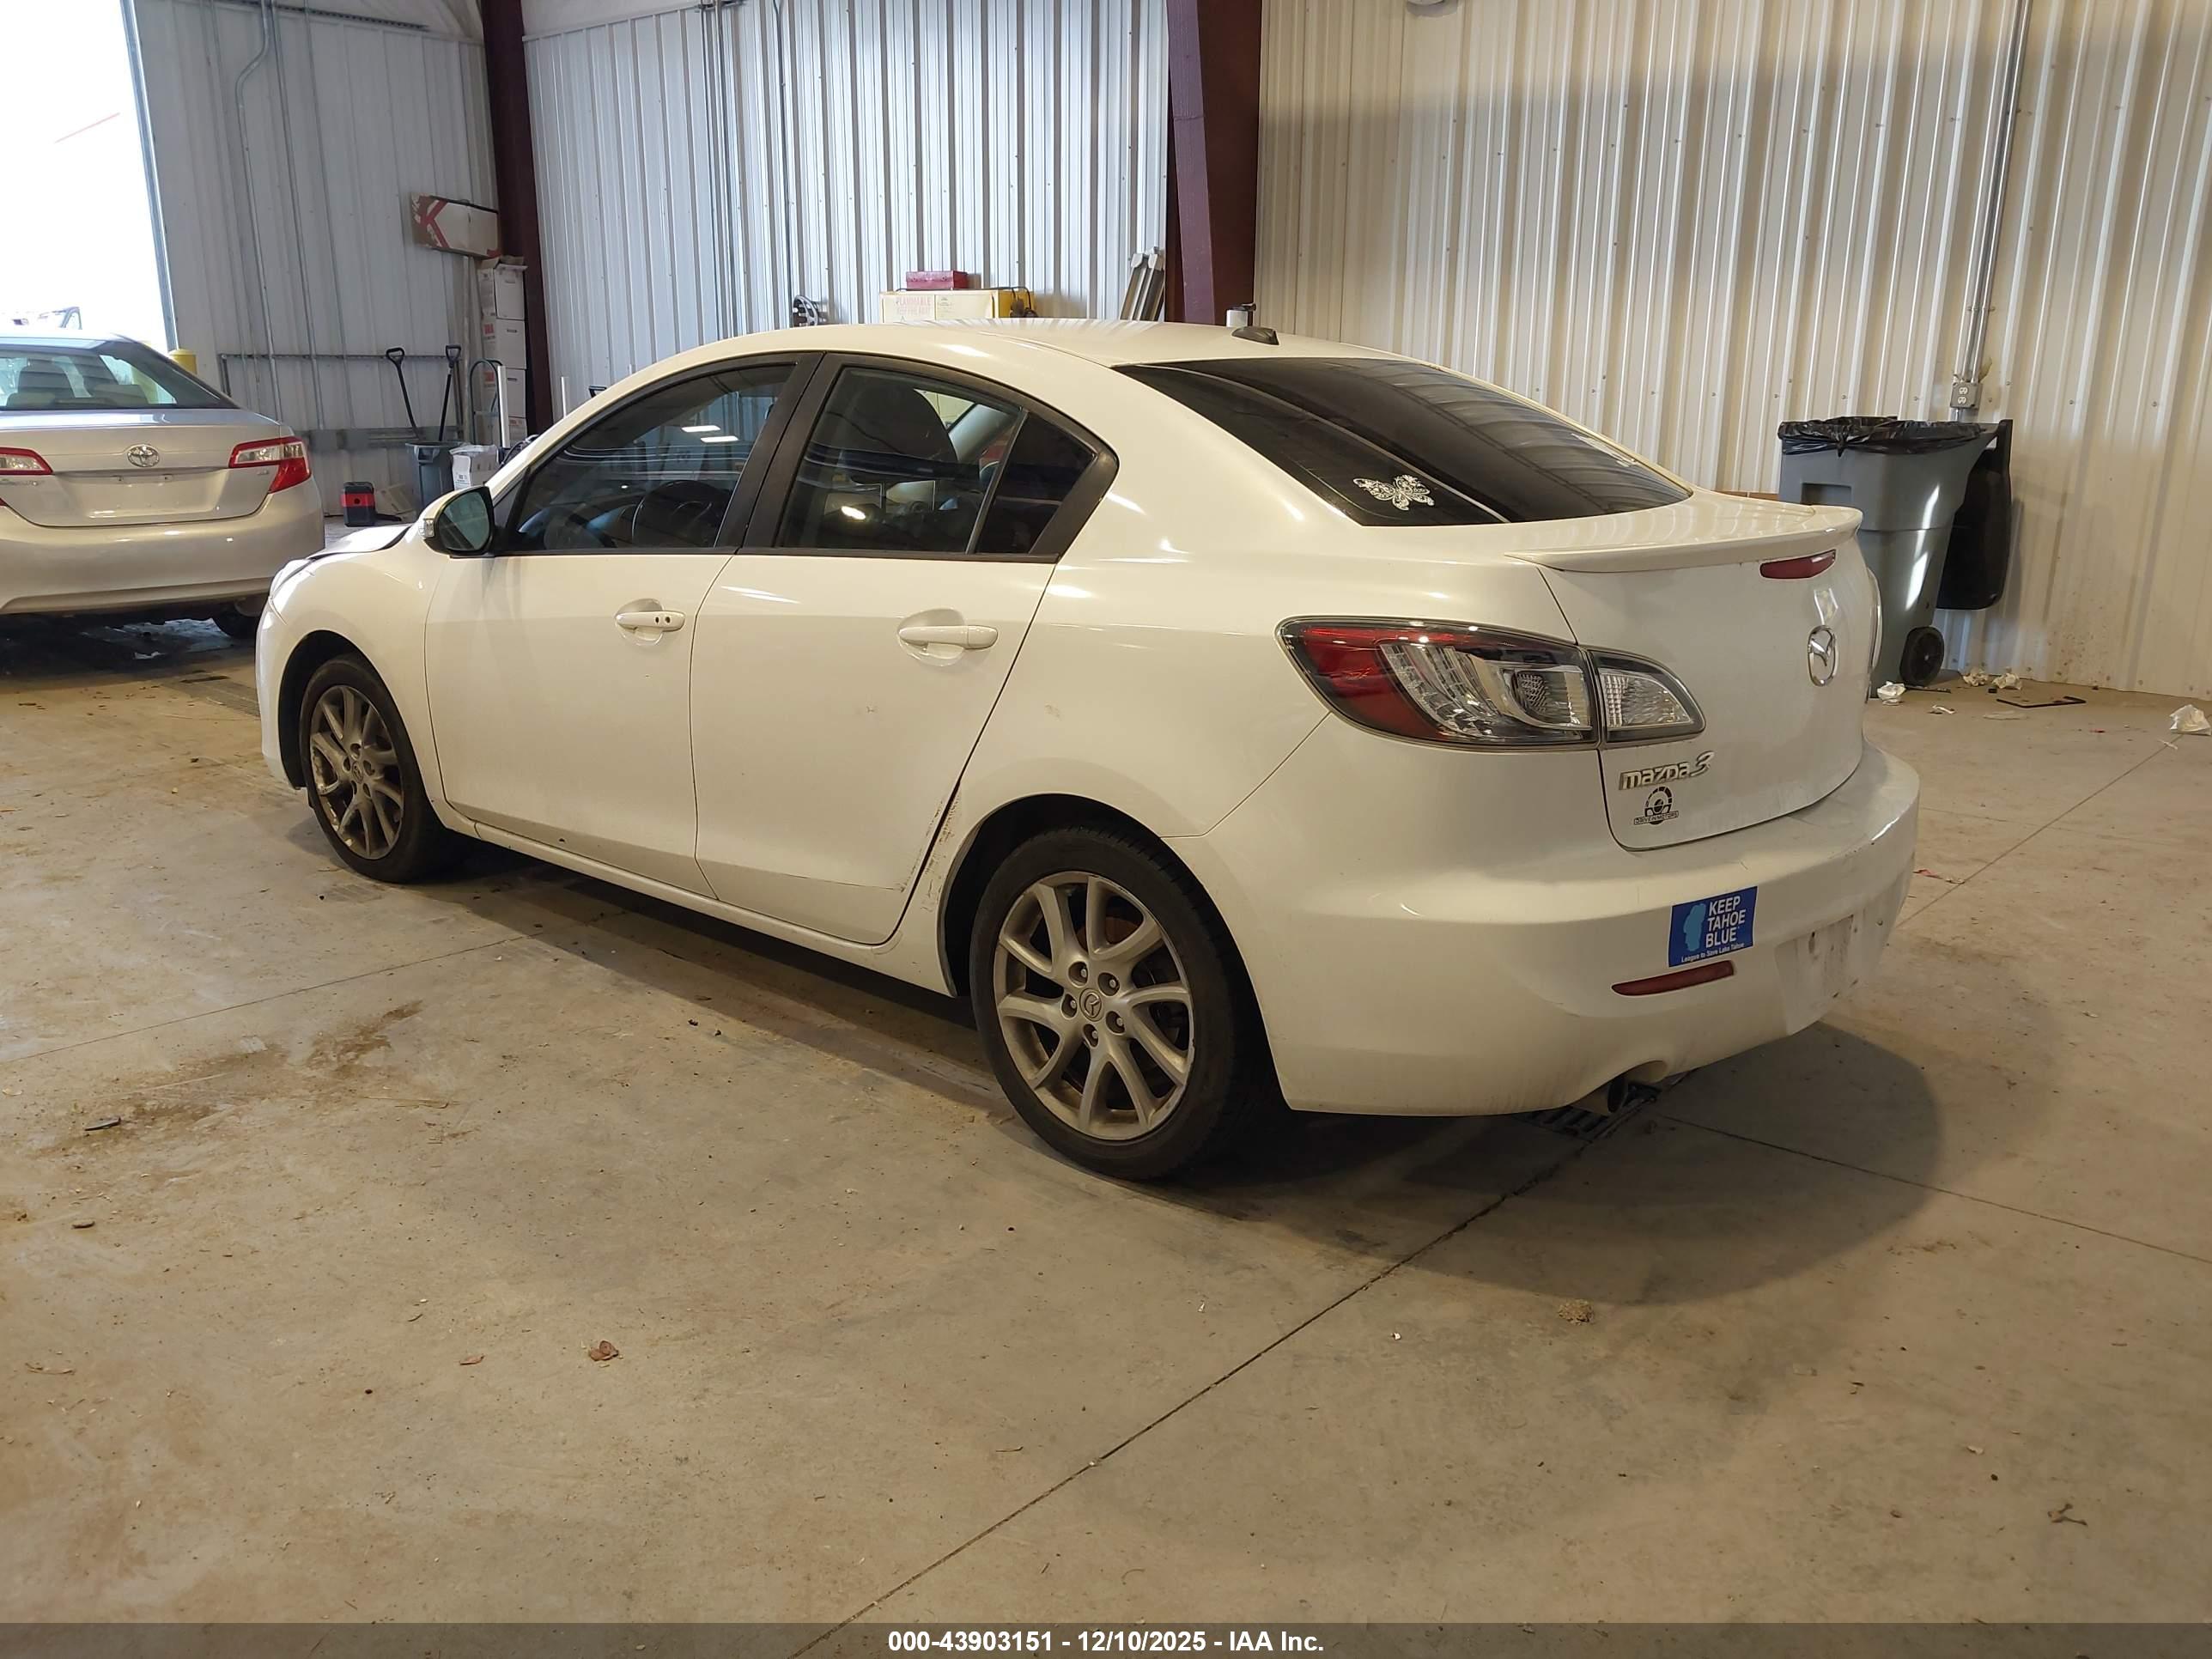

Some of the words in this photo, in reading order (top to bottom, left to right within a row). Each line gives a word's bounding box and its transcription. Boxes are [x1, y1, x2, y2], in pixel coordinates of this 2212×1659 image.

[1709, 896, 1741, 916] KEEP
[1707, 909, 1747, 932] TAHOE
[1705, 927, 1737, 948] BLUE
[1706, 948, 1718, 957] Save
